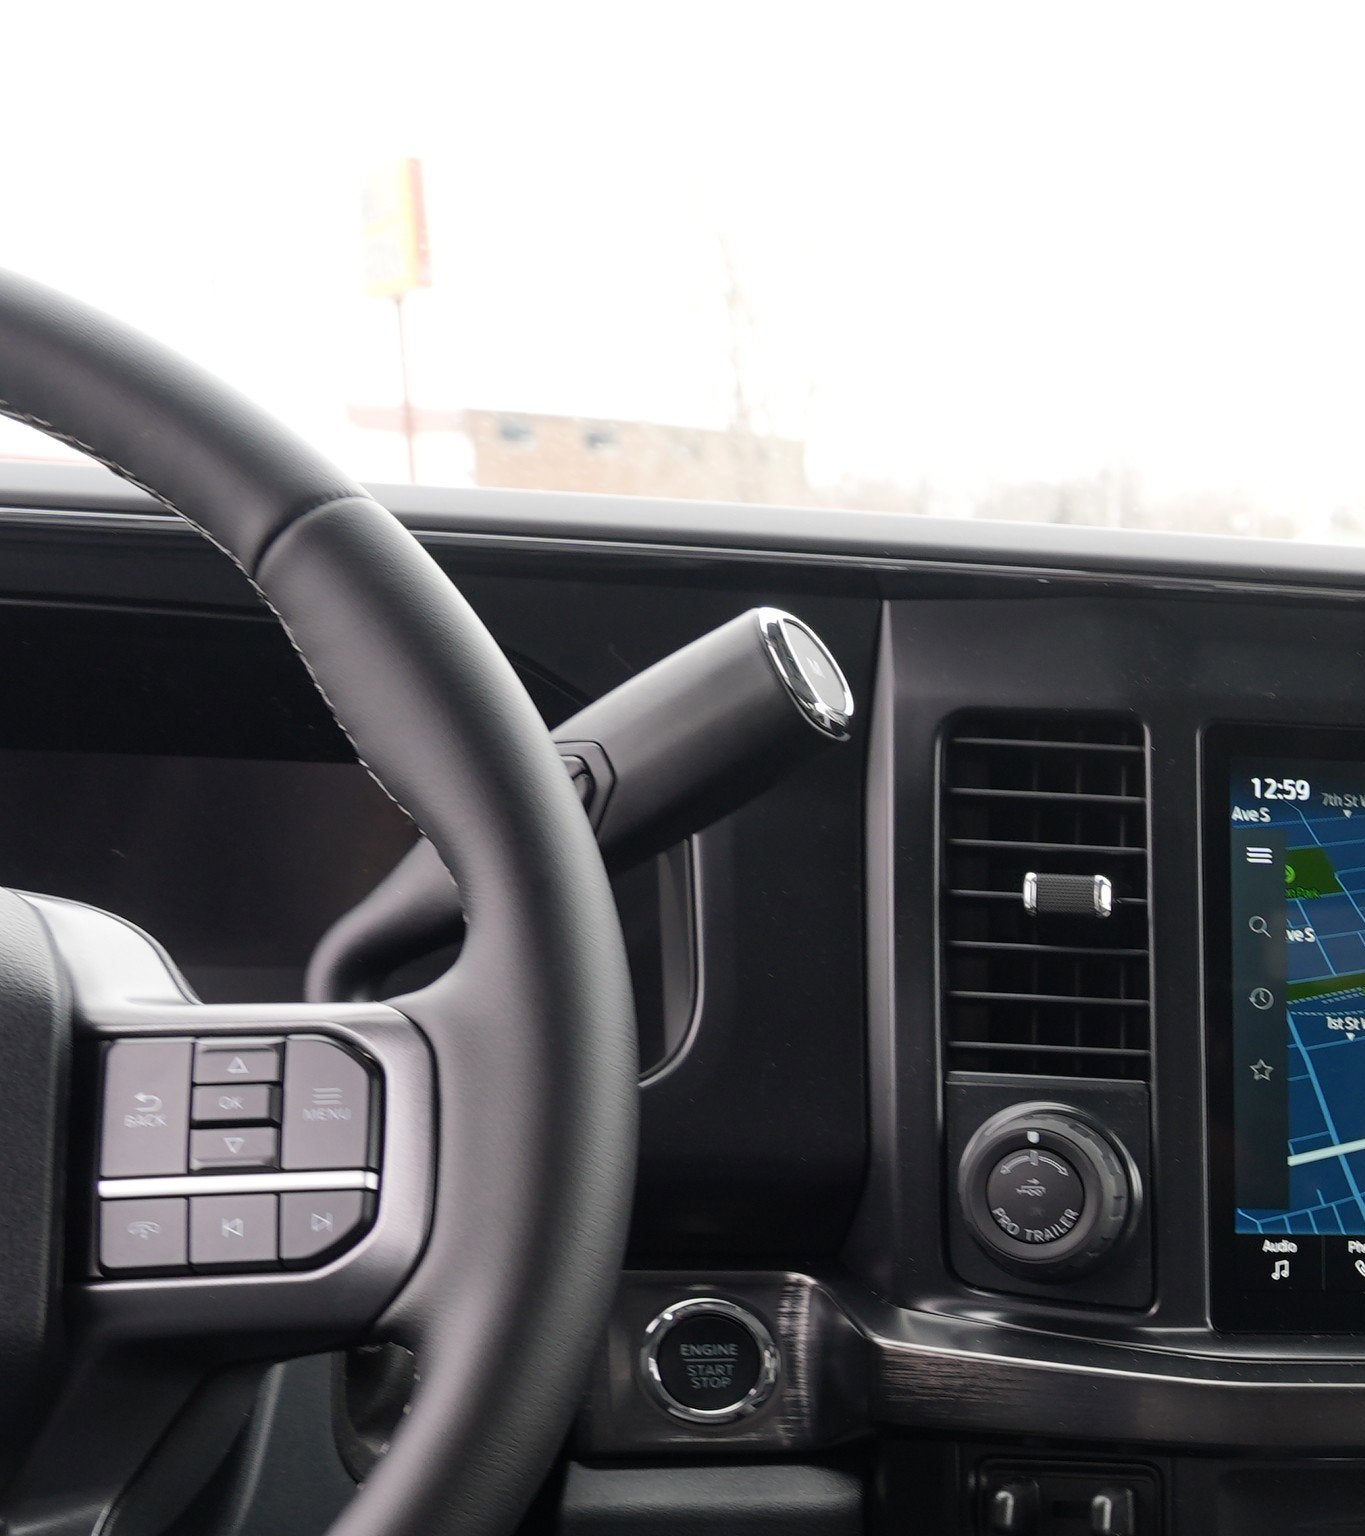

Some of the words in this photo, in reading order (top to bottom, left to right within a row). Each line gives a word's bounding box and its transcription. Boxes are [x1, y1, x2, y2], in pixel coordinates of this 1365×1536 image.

[1250, 778, 1310, 801] 12:59
[1322, 792, 1343, 808] 7th
[1344, 793, 1357, 808] St
[1231, 806, 1257, 822] Ave
[1257, 807, 1271, 822] S
[1304, 927, 1316, 943] S
[1327, 1016, 1344, 1030] 1st
[1344, 1017, 1356, 1030] St
[218, 1095, 244, 1110] OK
[124, 1114, 168, 1128] BACK
[302, 1108, 352, 1121] MENU
[992, 1207, 1020, 1235] PRO
[1023, 1208, 1079, 1242] TRAILER
[1262, 1239, 1298, 1254] Audio
[680, 1343, 739, 1356] ENGINE
[687, 1364, 735, 1377] START
[691, 1377, 732, 1390] STOP
